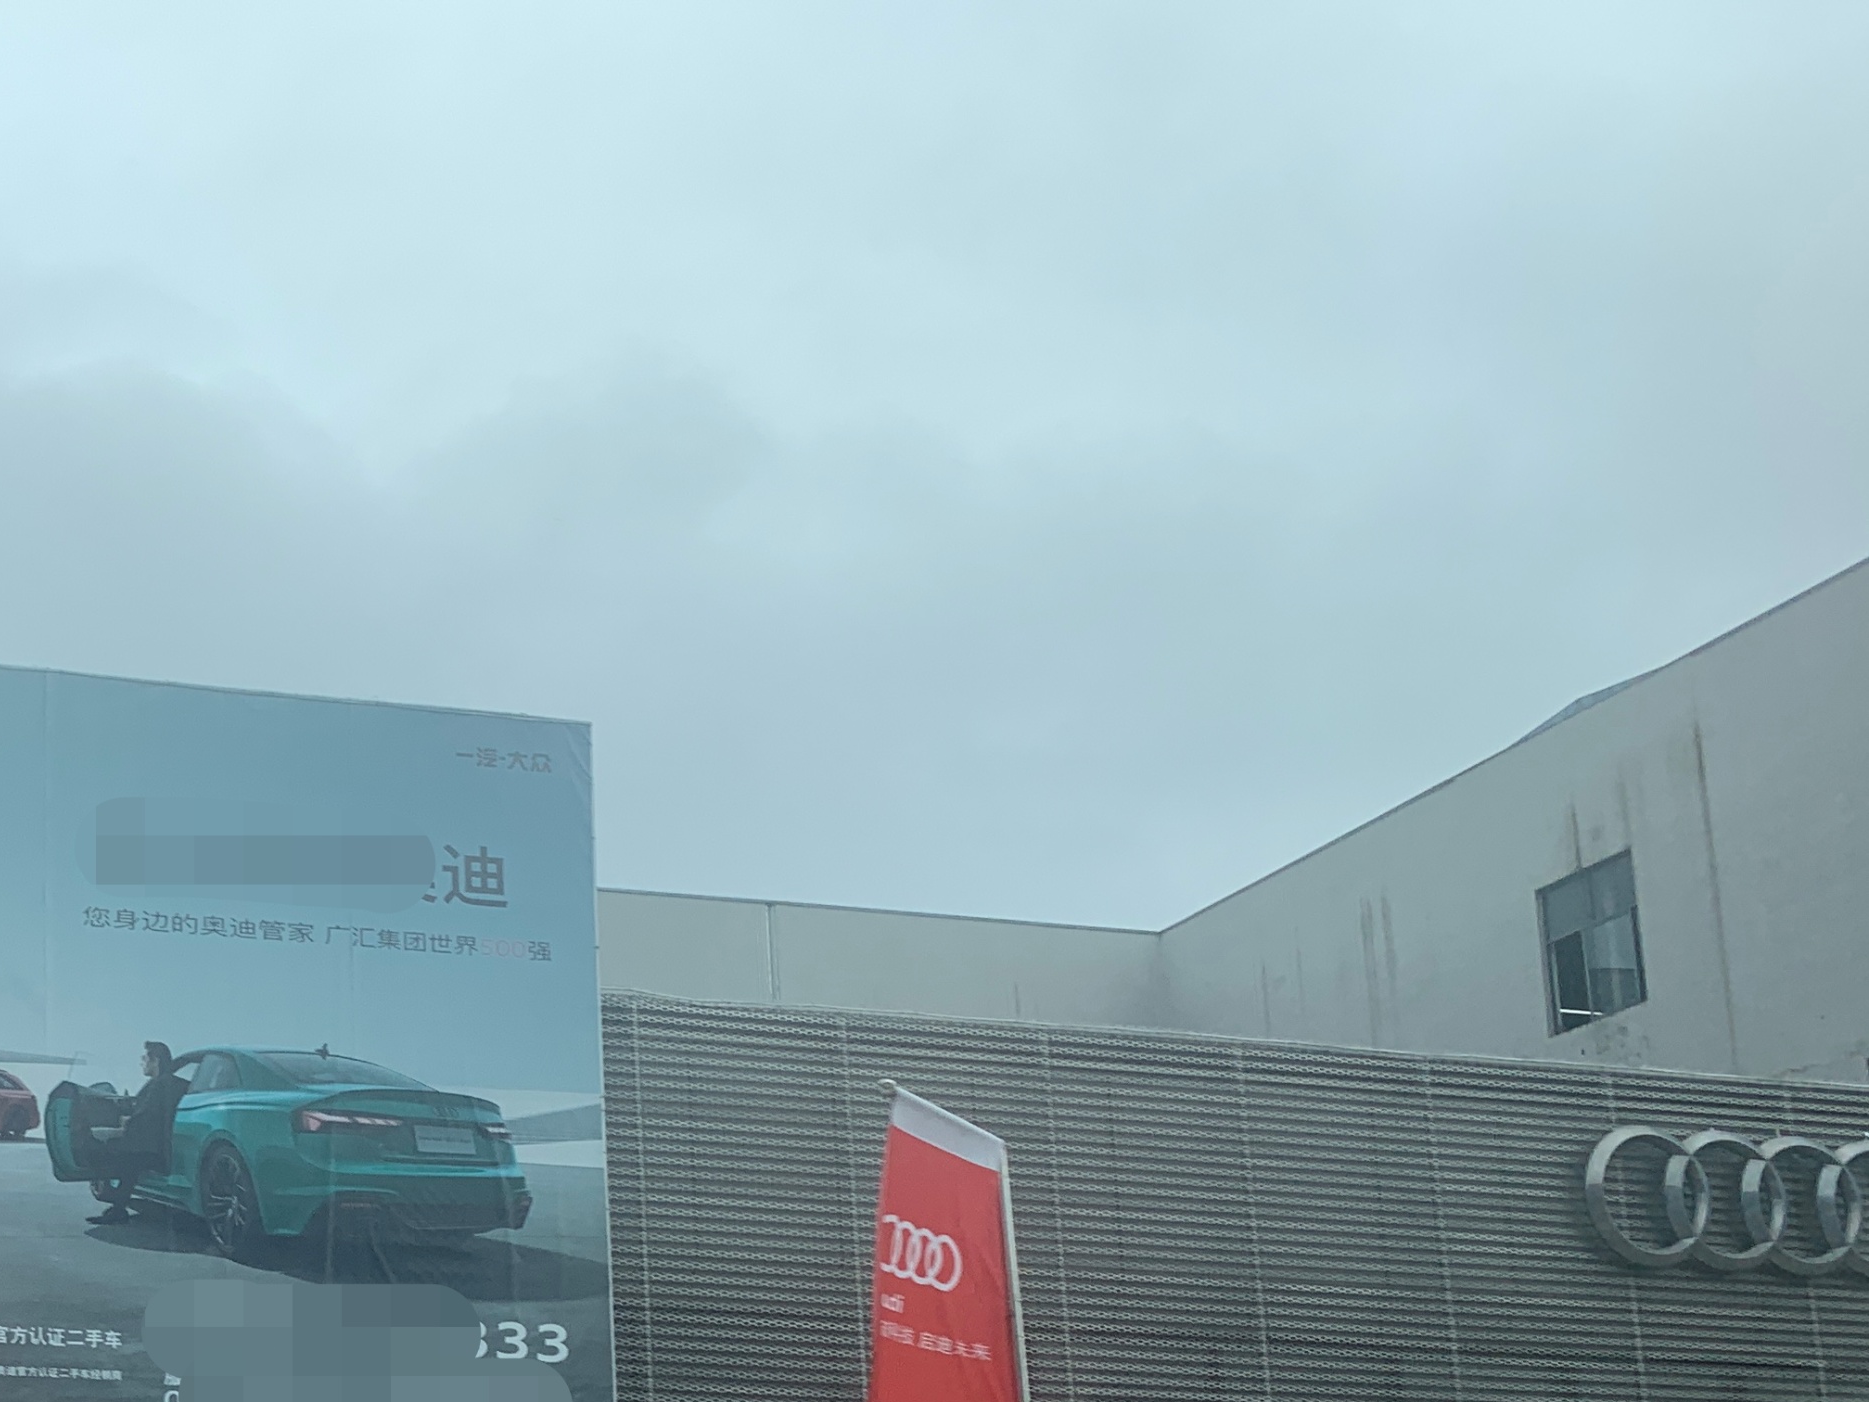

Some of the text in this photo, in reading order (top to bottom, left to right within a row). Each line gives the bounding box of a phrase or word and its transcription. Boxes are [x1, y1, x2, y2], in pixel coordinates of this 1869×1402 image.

[422, 844, 509, 909] 迪
[82, 906, 553, 963] 您身边的奥迪管家 广汇集团世界500强
